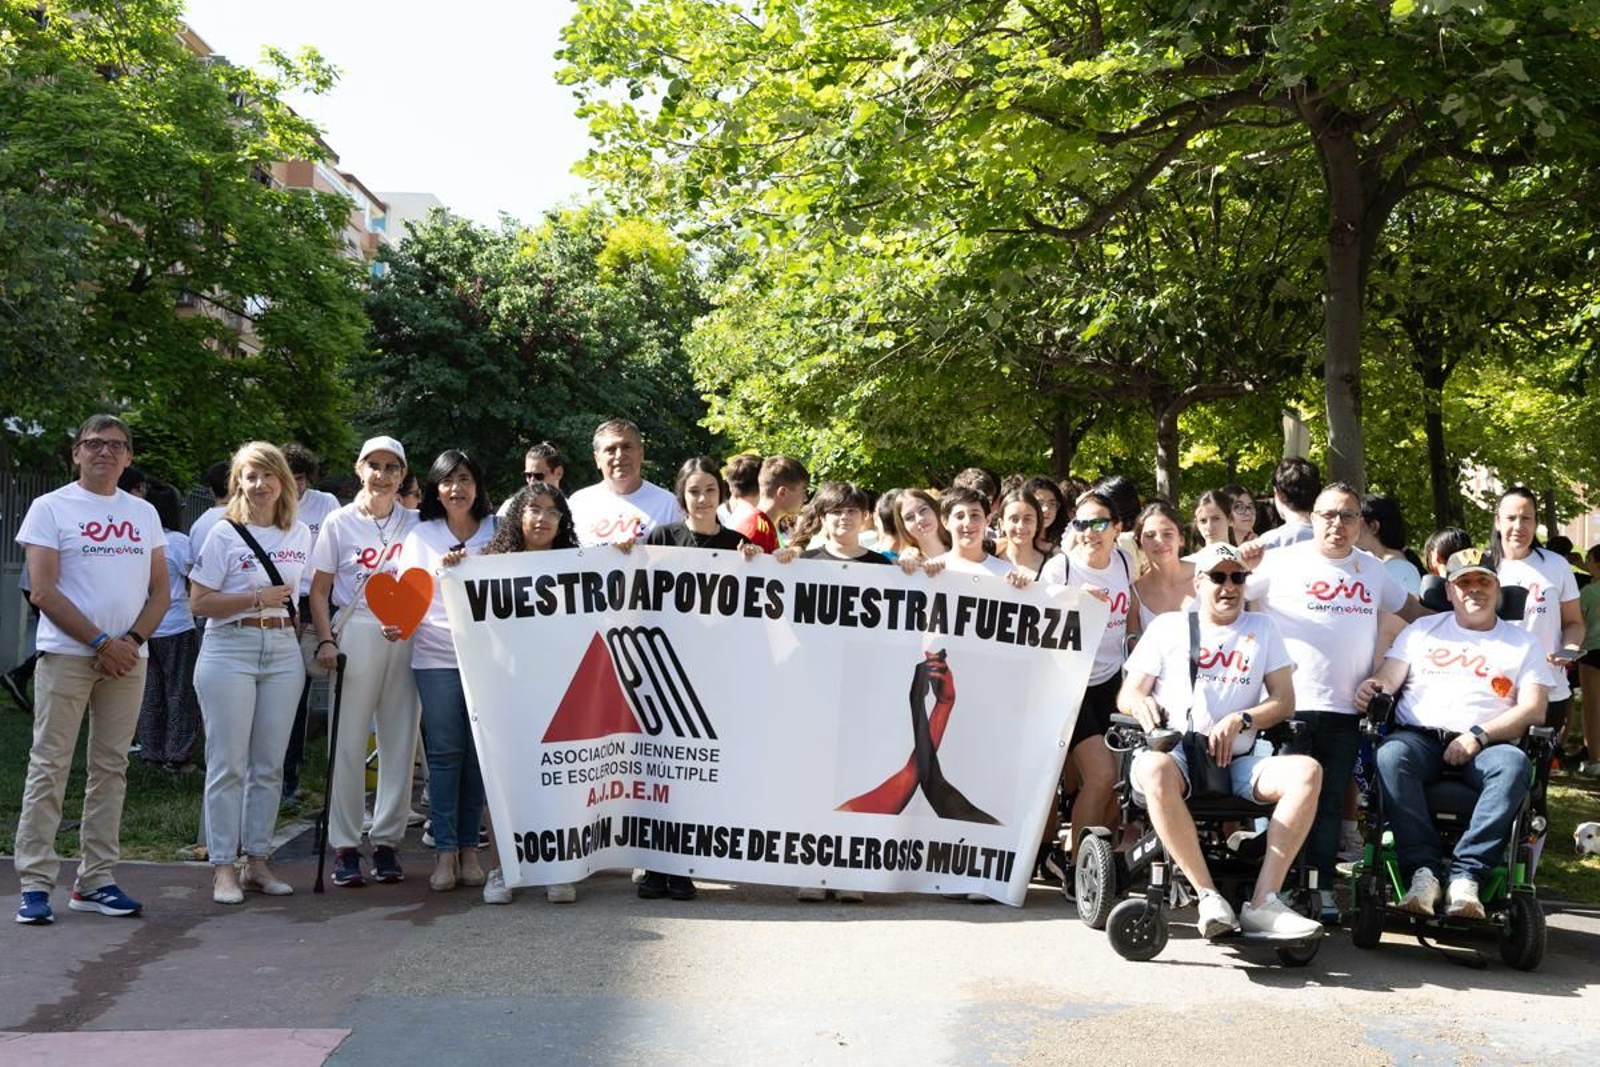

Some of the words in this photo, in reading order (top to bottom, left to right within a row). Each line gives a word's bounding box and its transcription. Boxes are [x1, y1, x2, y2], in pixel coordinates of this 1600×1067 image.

[464, 570, 626, 622] VUESTRO
[628, 568, 739, 616] APOYO
[744, 576, 785, 620] ES
[793, 582, 948, 636] NUESTRA
[954, 595, 1082, 651] FUERZA
[540, 740, 625, 766] ASOCIACIÓN
[630, 742, 720, 763] JIENNENSE
[541, 771, 563, 786] DE
[568, 761, 642, 784] ESCLEROSIS
[646, 762, 719, 783] MÚLTIPLE
[614, 816, 745, 860] JIENNENSE
[747, 829, 780, 863] DE
[784, 832, 924, 872] ESCLEROSIS
